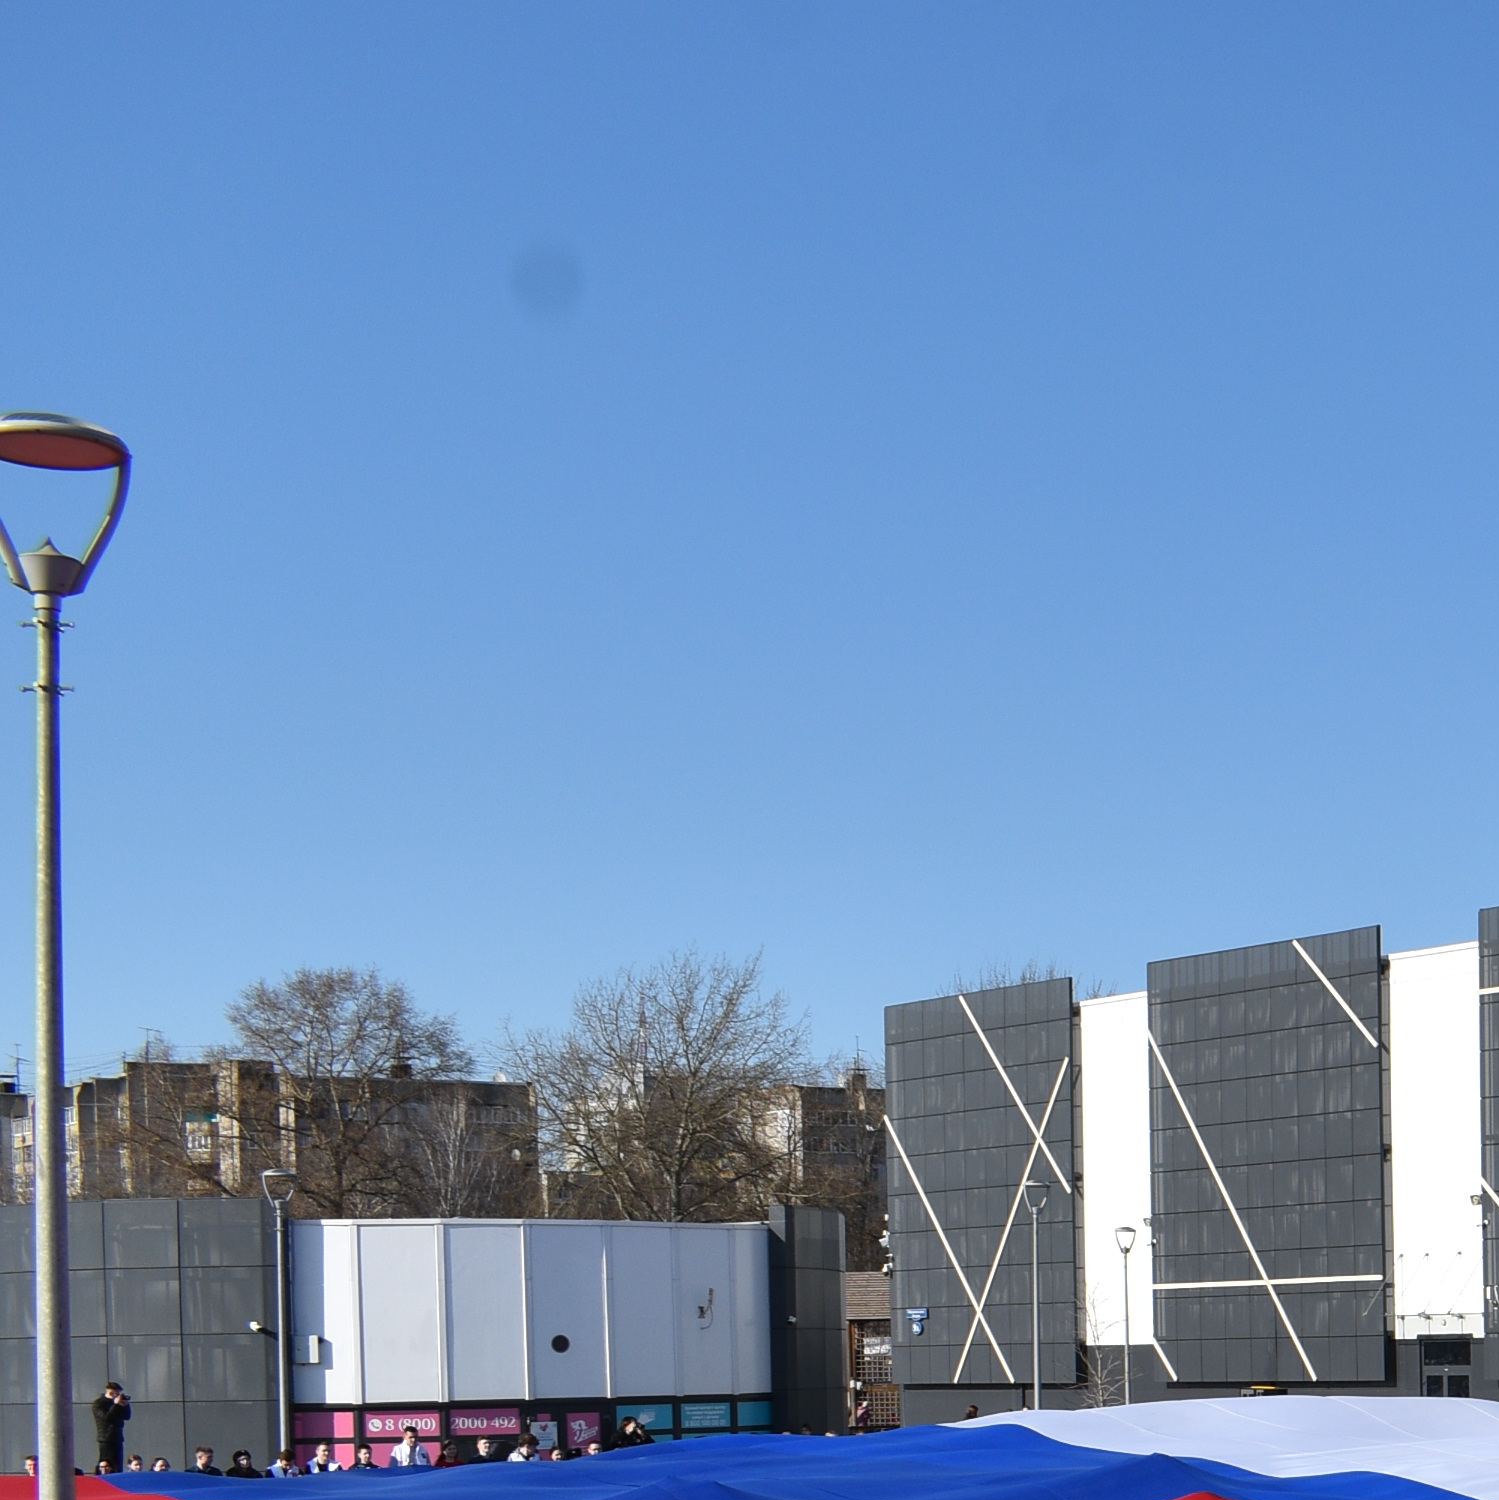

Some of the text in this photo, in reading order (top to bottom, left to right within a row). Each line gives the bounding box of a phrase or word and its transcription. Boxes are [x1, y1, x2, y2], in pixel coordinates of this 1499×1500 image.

[385, 1415, 516, 1433] 8 (800) 2000 492
